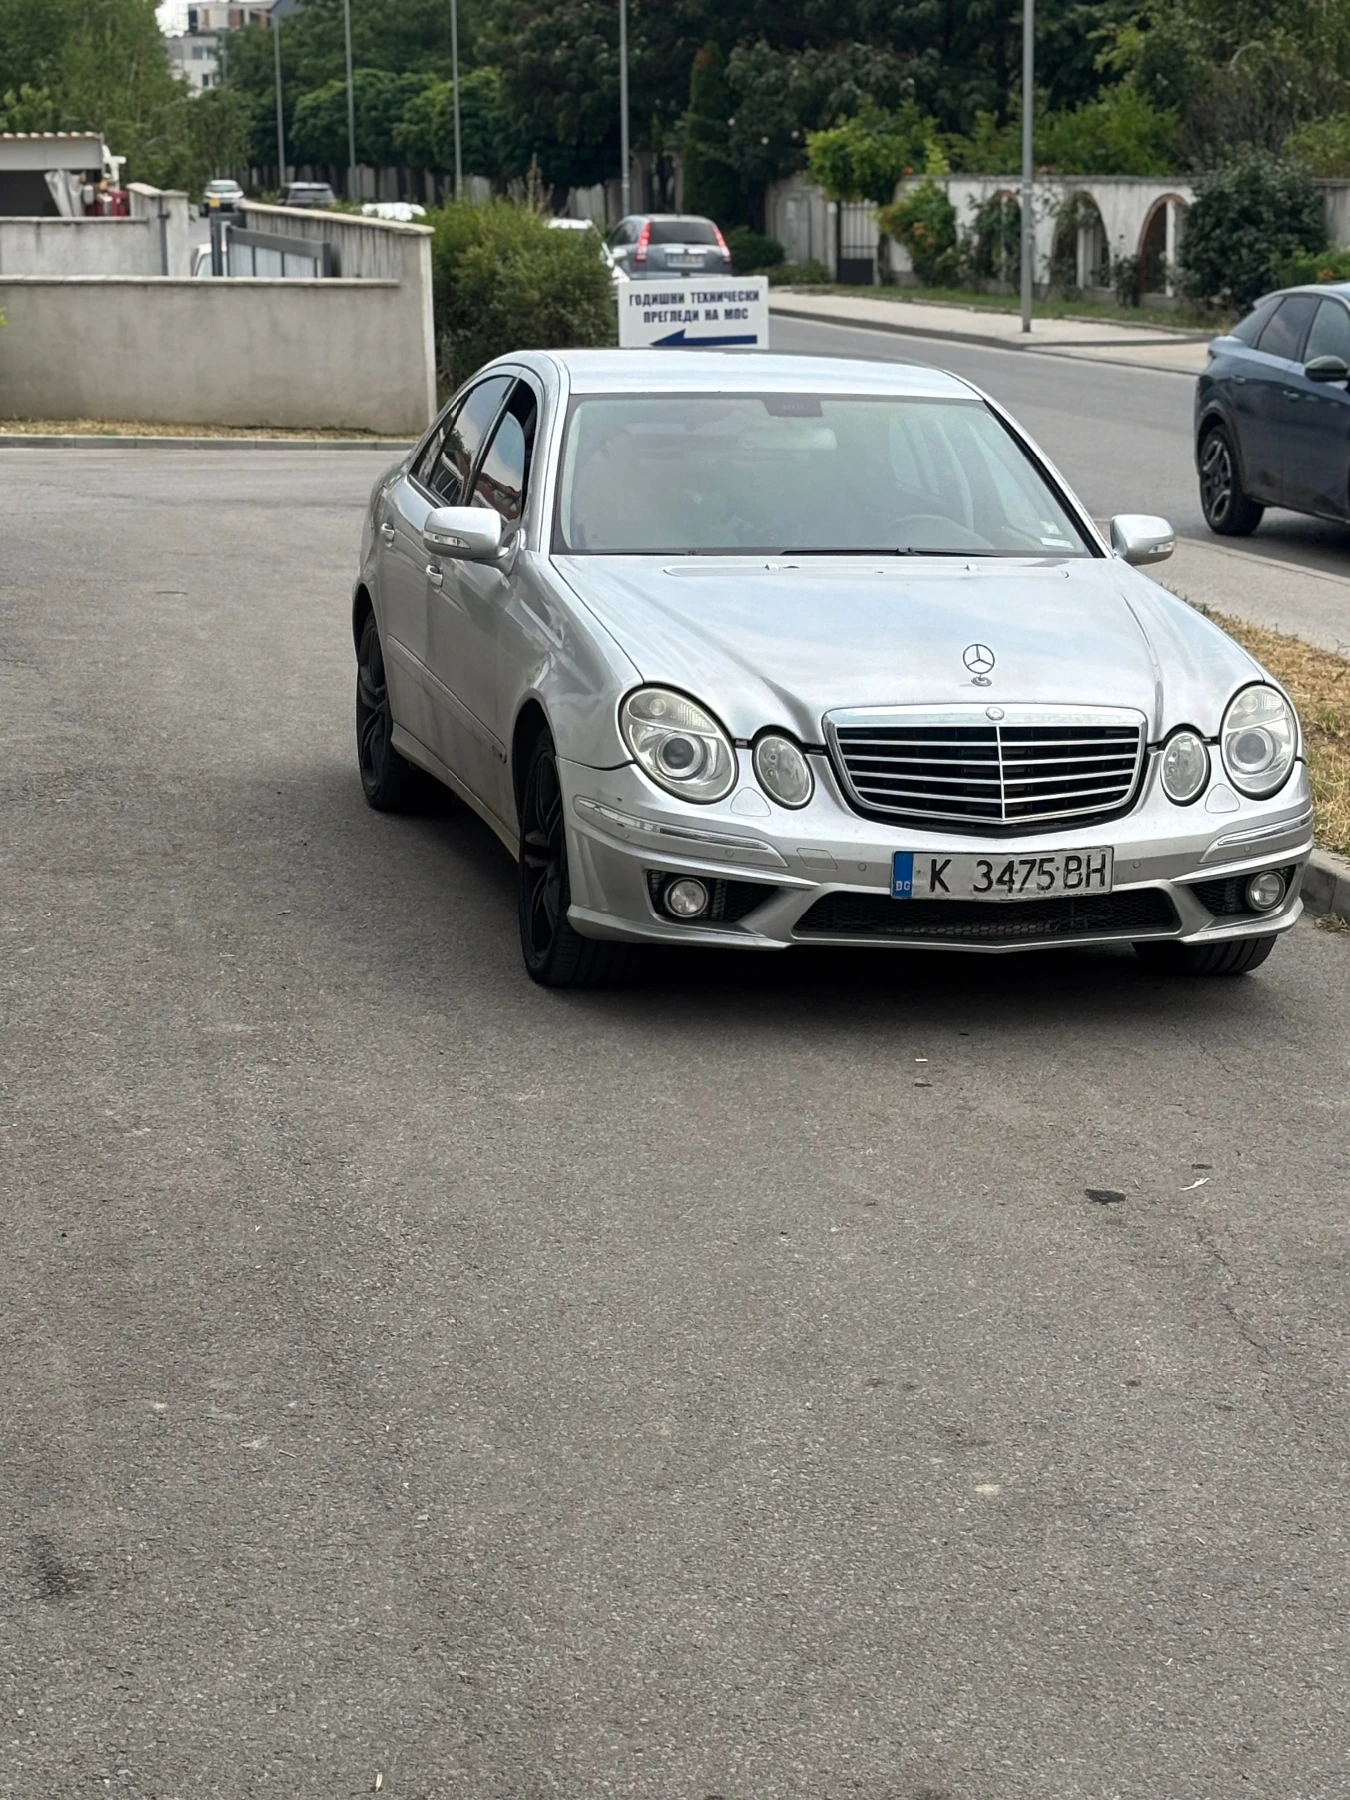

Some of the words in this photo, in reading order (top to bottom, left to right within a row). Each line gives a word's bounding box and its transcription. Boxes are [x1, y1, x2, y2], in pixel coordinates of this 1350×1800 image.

[629, 292, 685, 307] ГОДИШНИ
[690, 290, 760, 304] ТЕХНИЧЕСКИ
[643, 310, 699, 323] ПРЕГЛЕДИ
[704, 309, 719, 321] НА
[724, 308, 749, 320] МПС
[929, 858, 952, 893] K
[895, 880, 911, 892] BG
